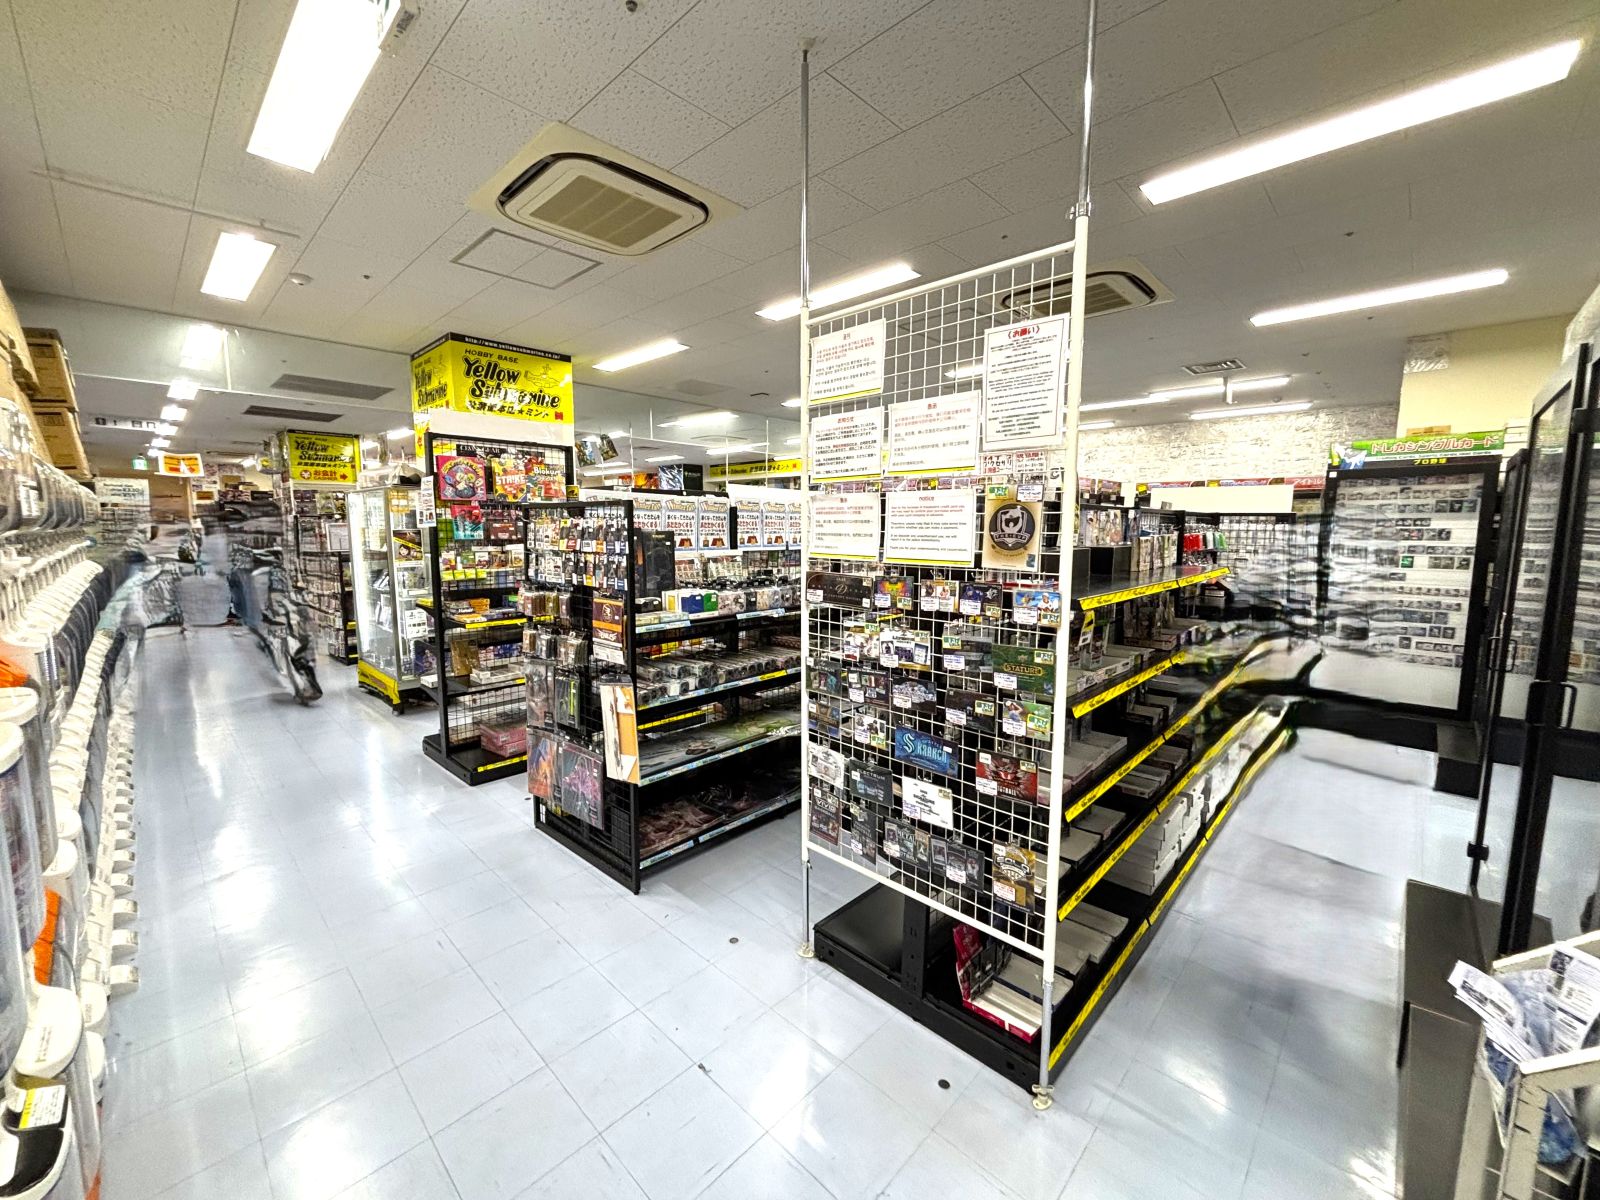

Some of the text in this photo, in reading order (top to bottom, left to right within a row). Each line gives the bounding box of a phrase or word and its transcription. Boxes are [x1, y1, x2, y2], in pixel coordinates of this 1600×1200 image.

[464, 348, 519, 364] HOBBY BASE
[462, 355, 521, 385] Yellow
[295, 440, 329, 453] Yellow
[1371, 434, 1499, 454] トレカシングルカード
[495, 474, 526, 485] STRIKE
[1007, 665, 1038, 674] STATURE
